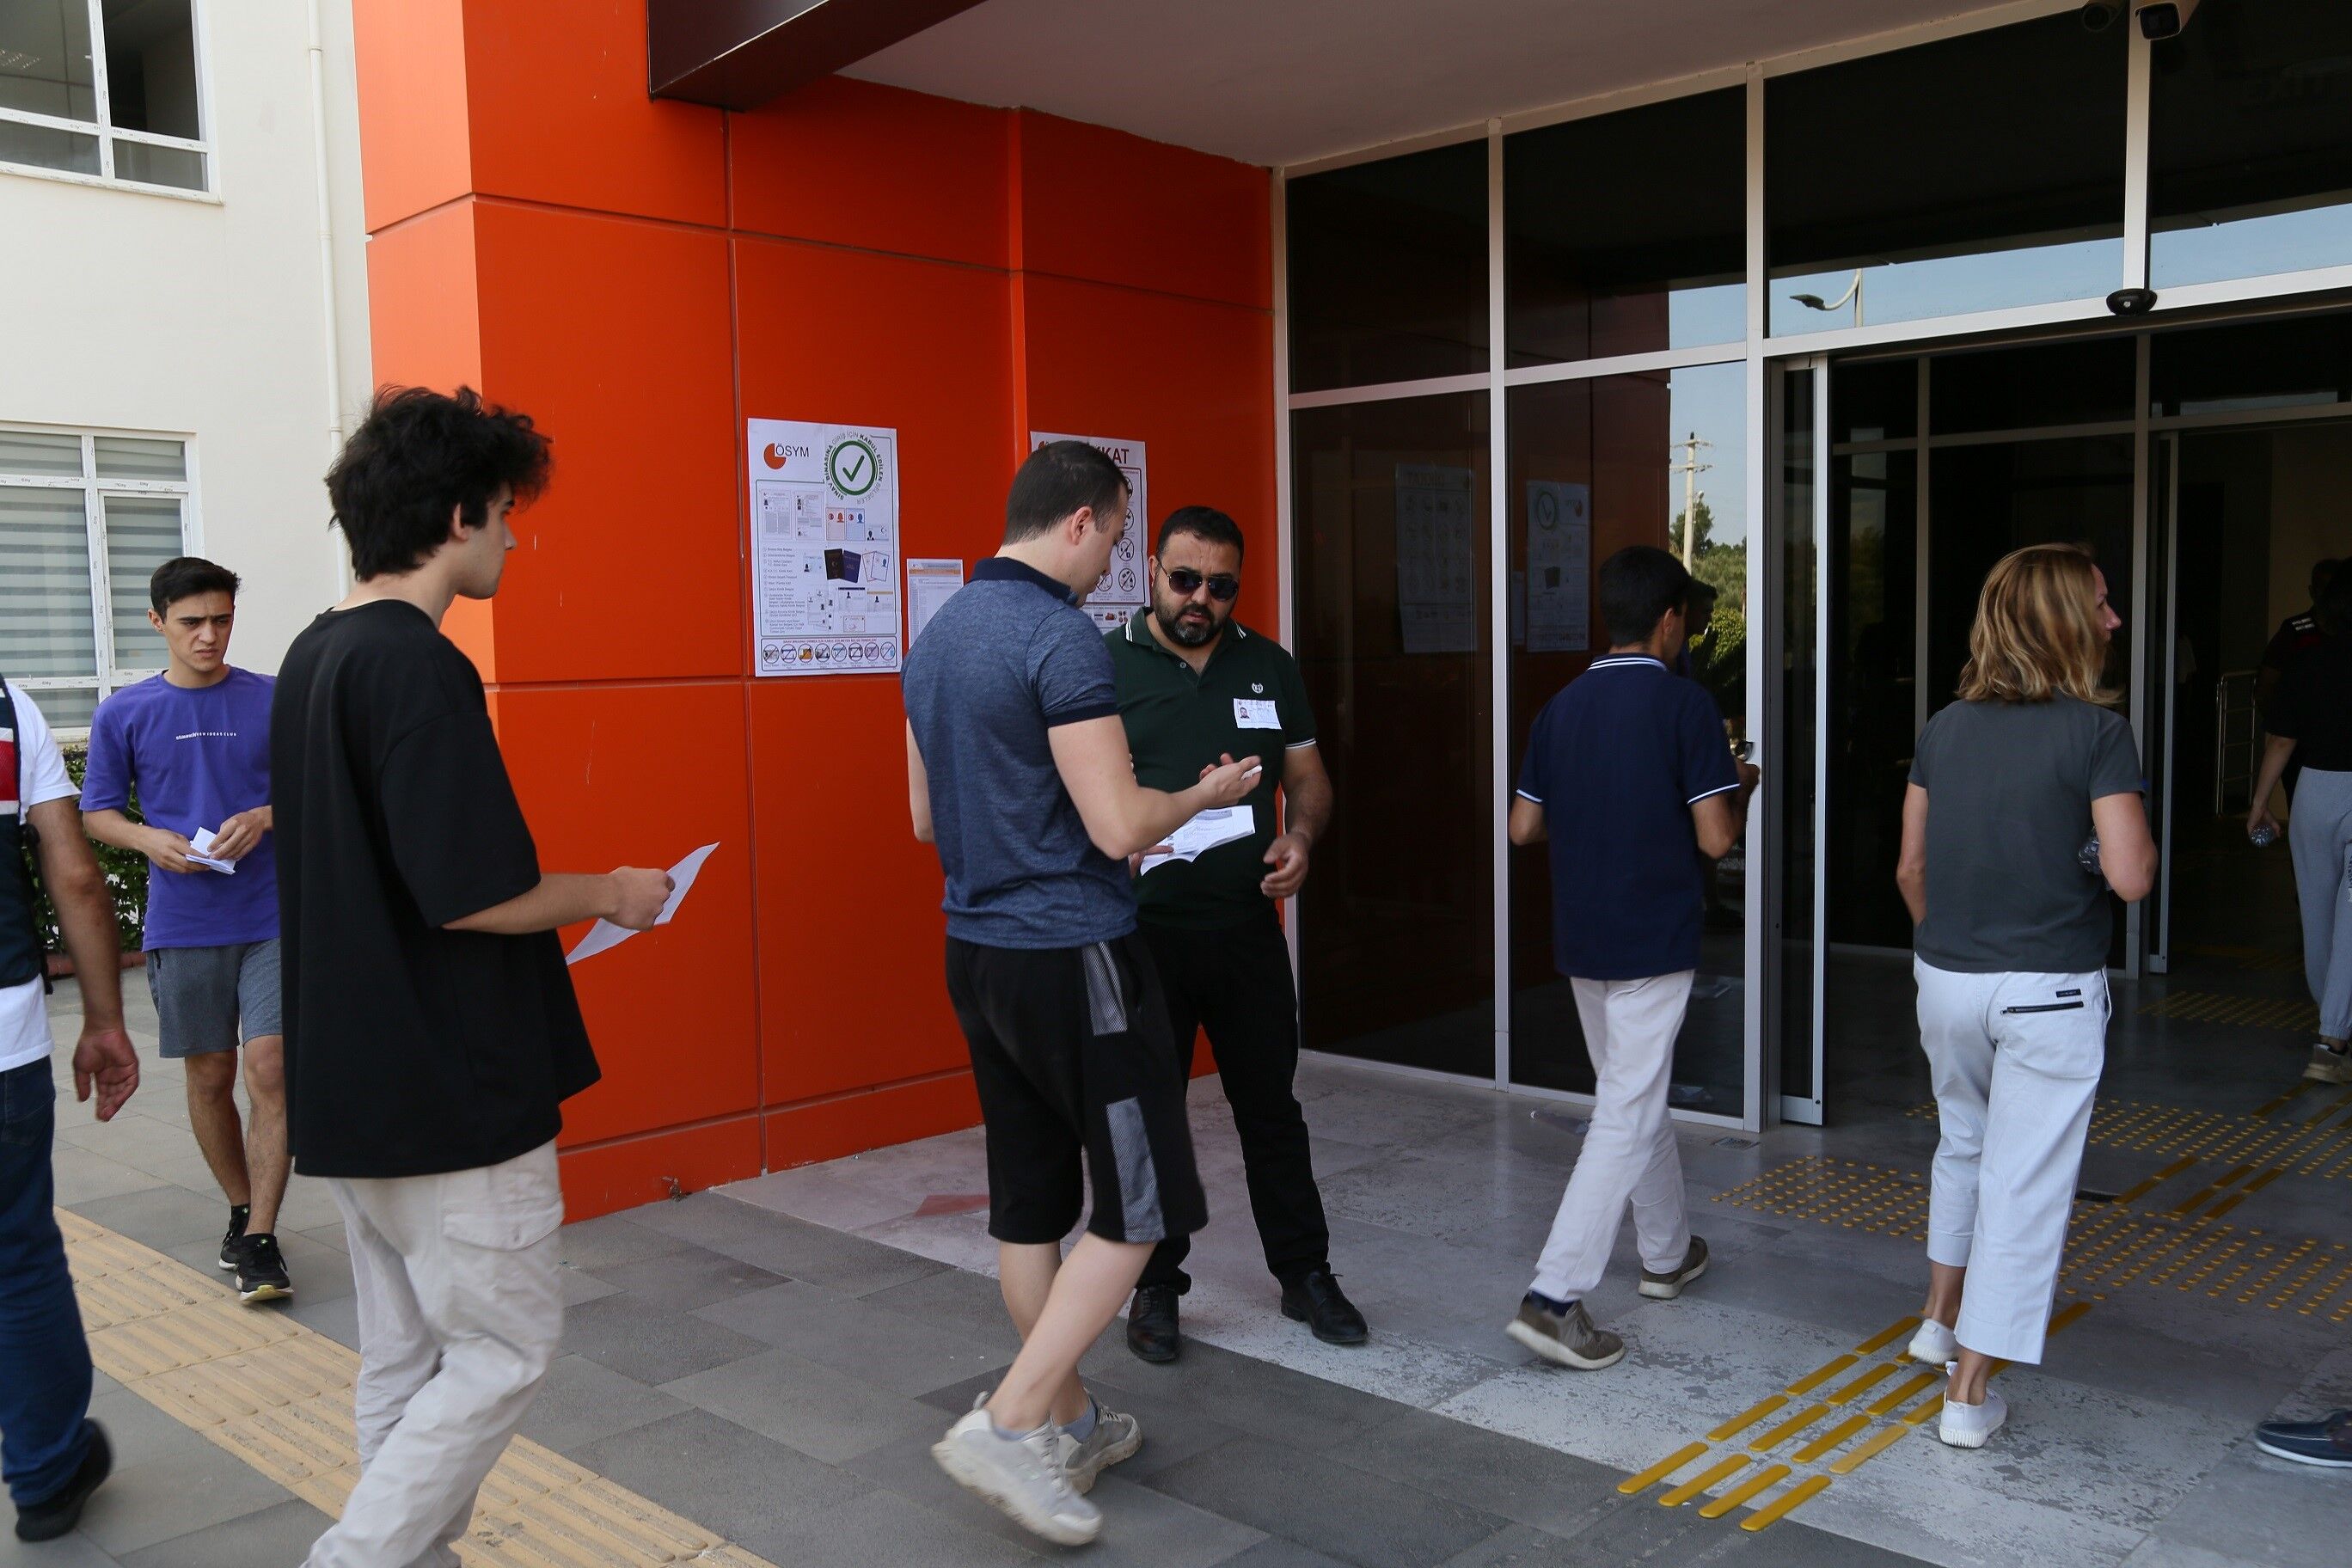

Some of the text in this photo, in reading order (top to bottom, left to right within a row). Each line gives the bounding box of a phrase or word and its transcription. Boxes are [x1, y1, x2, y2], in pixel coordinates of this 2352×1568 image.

[776, 444, 809, 456] ÖSYM
[828, 482, 844, 500] SINAV
[860, 434, 877, 452] KABUL
